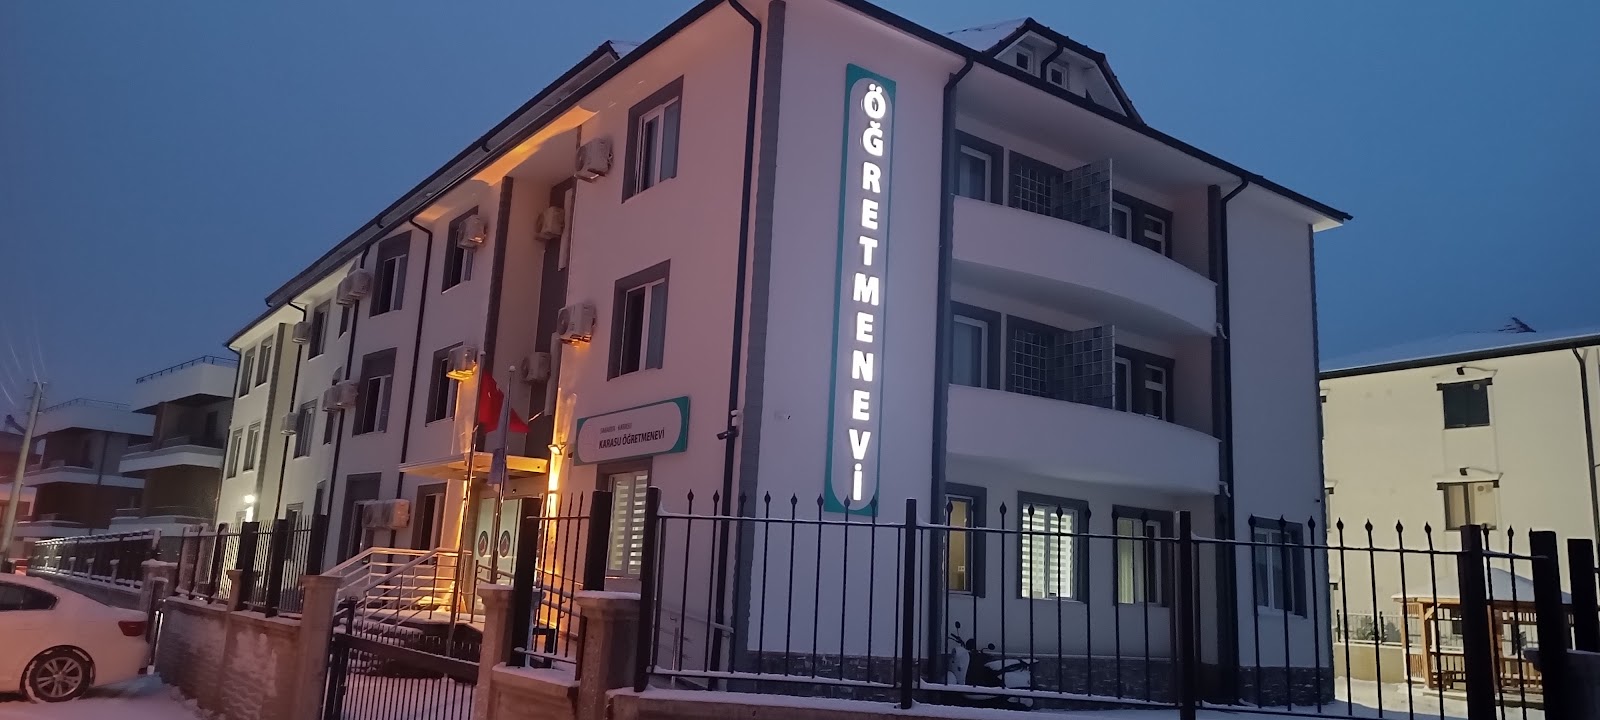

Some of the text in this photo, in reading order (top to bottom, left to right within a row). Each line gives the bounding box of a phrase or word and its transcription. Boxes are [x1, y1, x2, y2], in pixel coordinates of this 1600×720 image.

[849, 83, 886, 501] ÖĞRETMENEVİ
[599, 428, 664, 449] KARASU ÖĞRETMENEVİ
